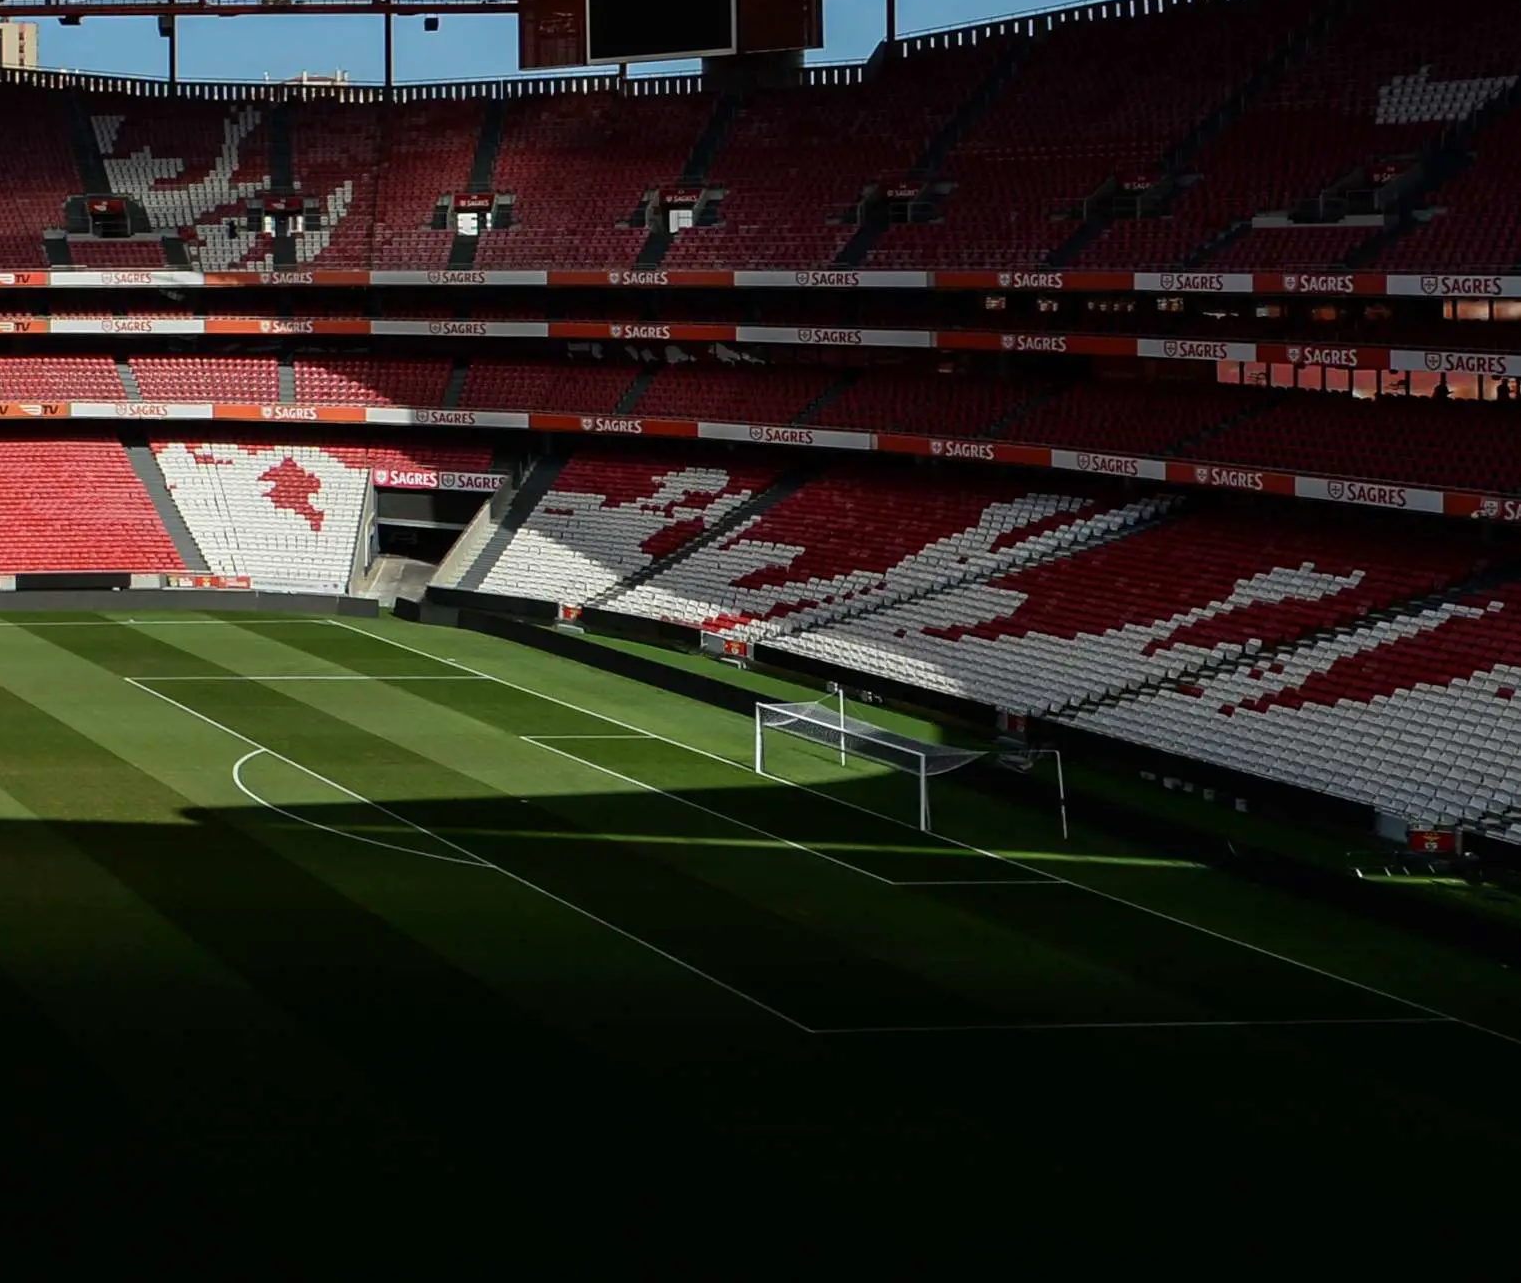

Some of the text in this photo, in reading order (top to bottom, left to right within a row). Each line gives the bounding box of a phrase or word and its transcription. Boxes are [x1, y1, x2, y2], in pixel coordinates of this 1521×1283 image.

[113, 272, 152, 284] SAGRES
[272, 272, 313, 284] SAGRES
[442, 271, 485, 284] SAGRES
[622, 271, 668, 285] SAGRES
[811, 272, 859, 285] SAGRES
[1013, 273, 1063, 288] SAGRES
[1175, 275, 1224, 290] SAGRES
[1300, 275, 1355, 293] SAGRES
[1441, 277, 1503, 296] SAGRES
[114, 321, 152, 332] SAGRES
[272, 321, 313, 333] SAGRES
[443, 322, 487, 334] SAGRES
[624, 325, 671, 339] SAGRES
[814, 329, 862, 344] SAGRES
[1017, 336, 1067, 352] SAGRES
[1178, 341, 1228, 359] SAGRES
[1303, 347, 1359, 366] SAGRES
[1445, 353, 1507, 375] SAGRES
[129, 405, 168, 416] SAGRES
[275, 407, 317, 420] SAGRES
[431, 412, 476, 425] SAGRES
[595, 418, 643, 434] SAGRES
[765, 430, 813, 444] SAGRES
[945, 444, 995, 460] SAGRES
[1092, 458, 1139, 476] SAGRES
[390, 470, 438, 487] SAGRES
[1210, 468, 1264, 491] SAGRES
[1347, 485, 1407, 507] SAGRES
